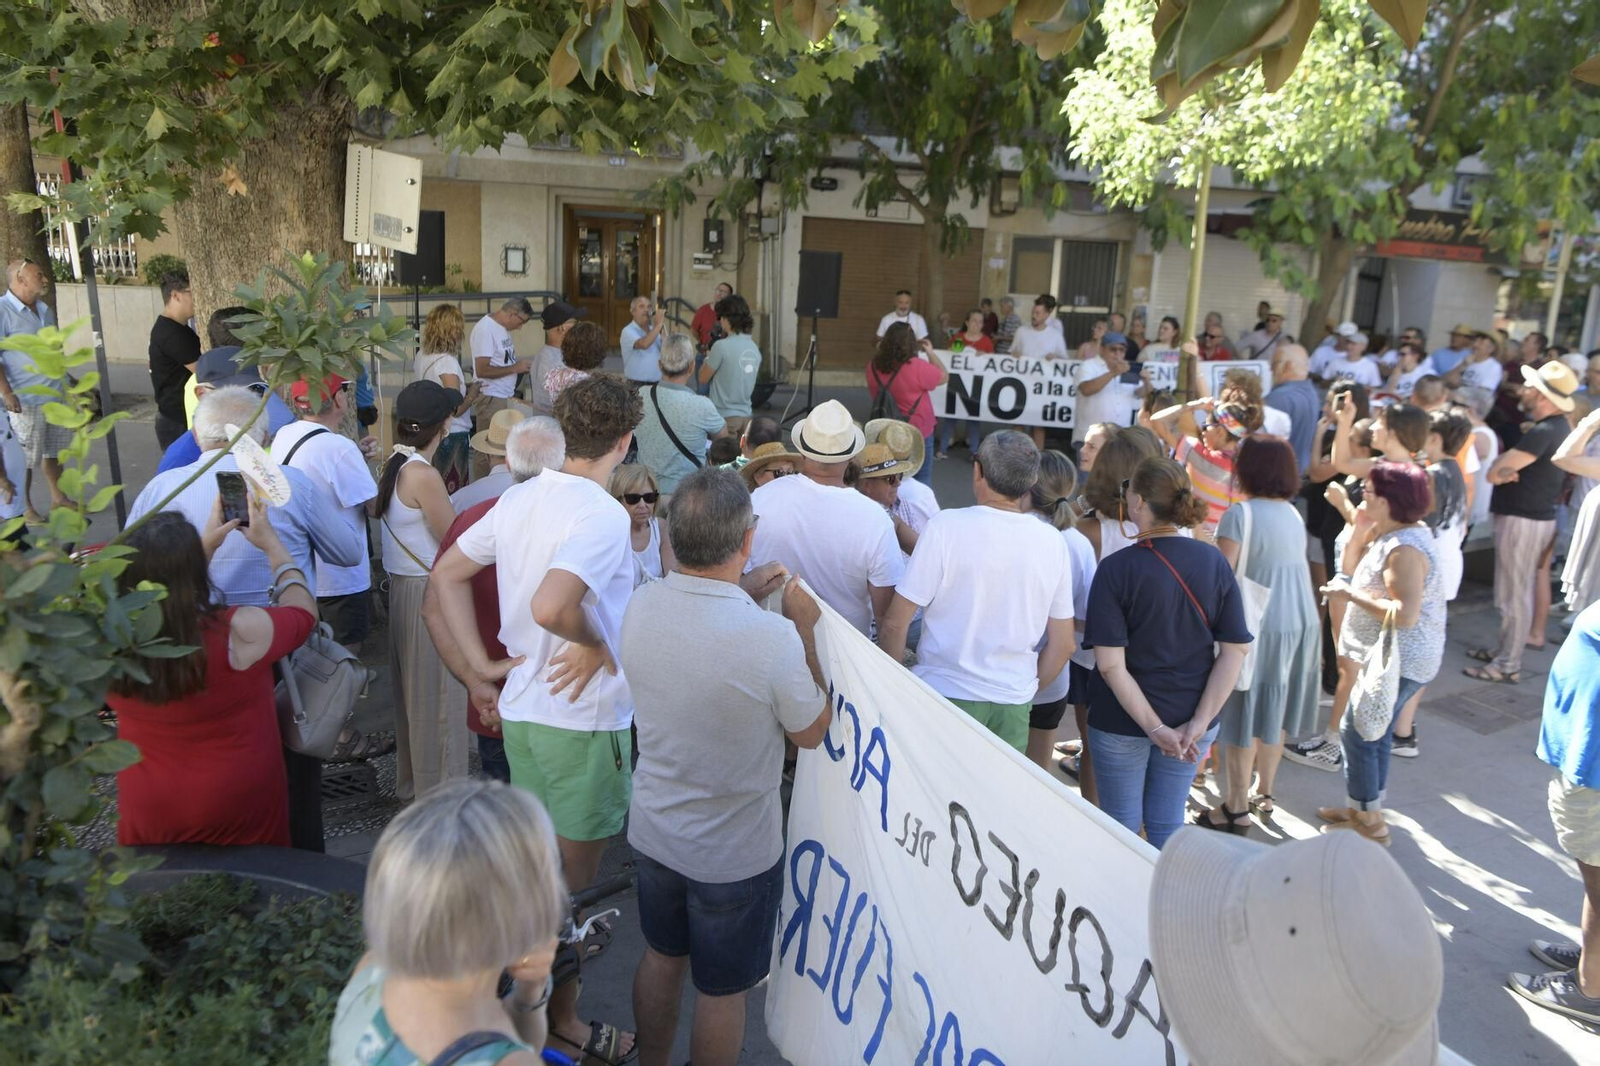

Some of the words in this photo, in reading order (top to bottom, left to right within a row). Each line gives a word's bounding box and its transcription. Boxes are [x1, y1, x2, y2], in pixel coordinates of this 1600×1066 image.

[950, 354, 975, 371] EL
[984, 357, 1045, 376] AGUA
[945, 372, 1027, 421] NO
[1033, 381, 1043, 395] a
[1048, 380, 1063, 396] la
[1042, 401, 1072, 423] de
